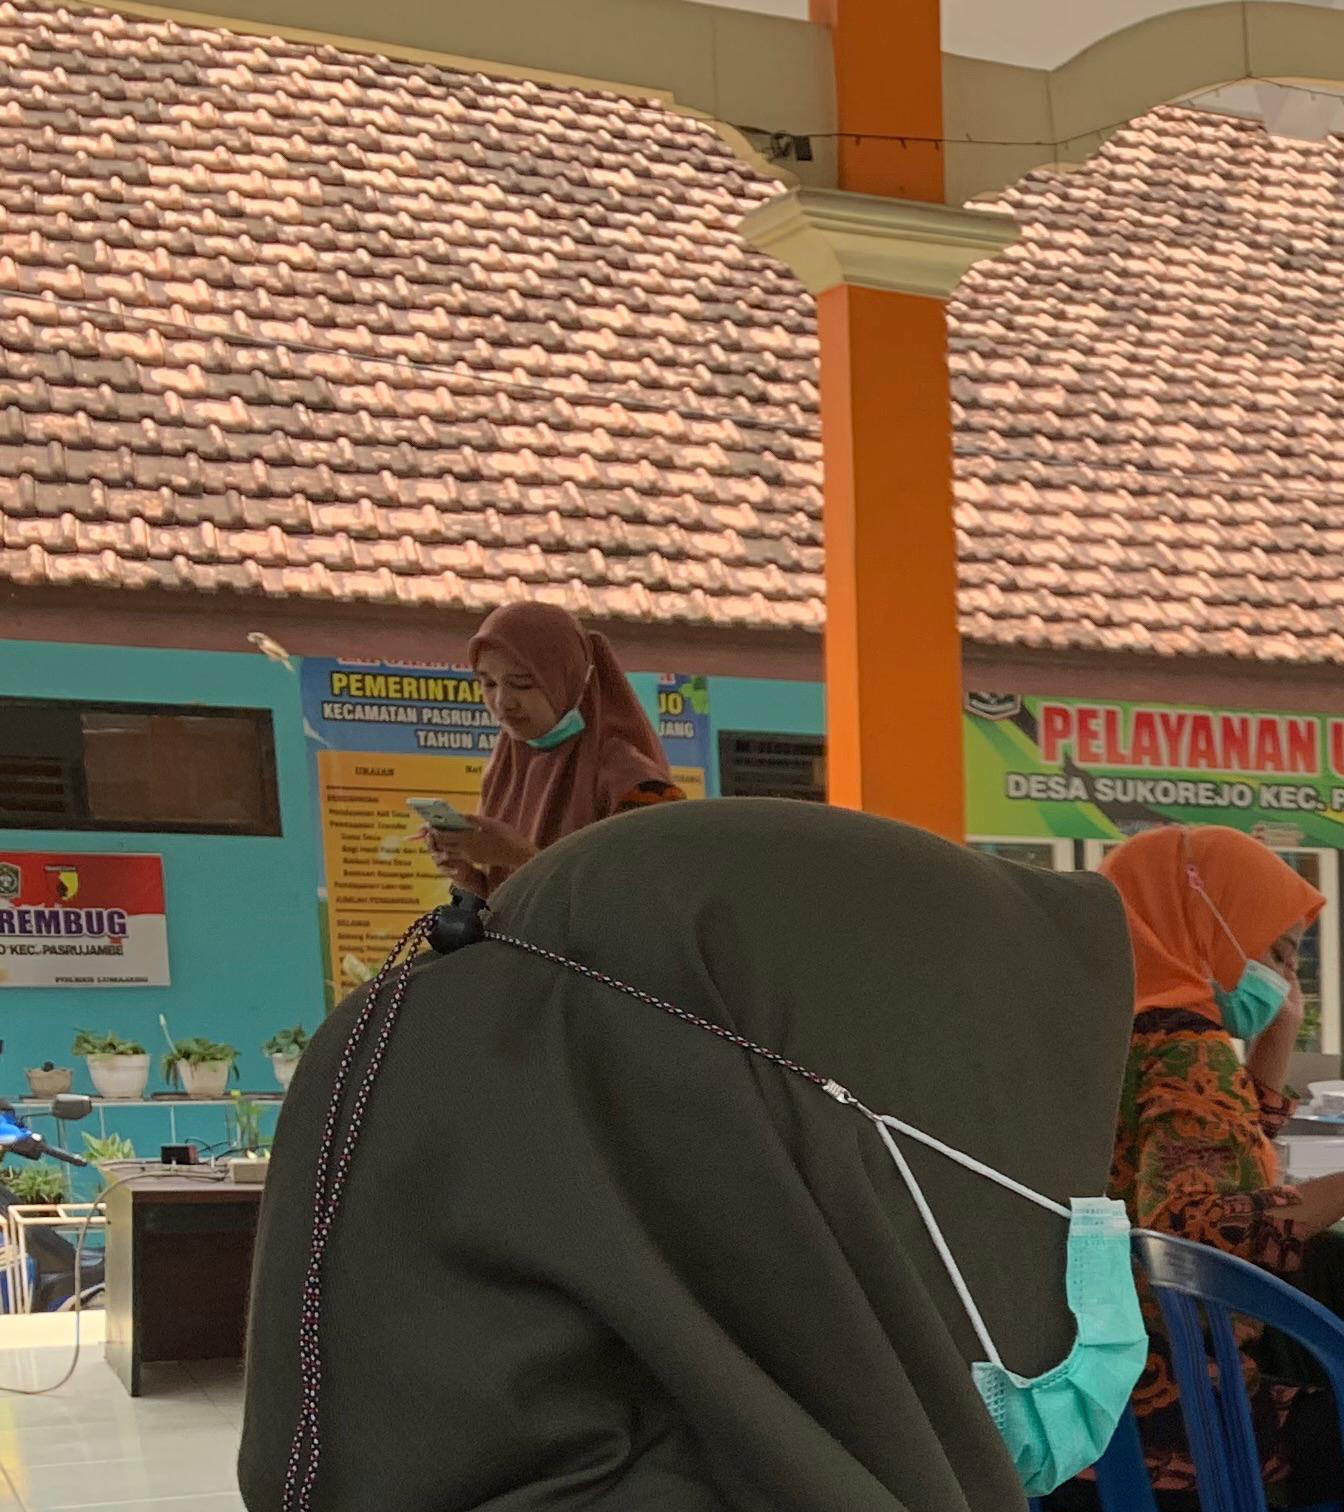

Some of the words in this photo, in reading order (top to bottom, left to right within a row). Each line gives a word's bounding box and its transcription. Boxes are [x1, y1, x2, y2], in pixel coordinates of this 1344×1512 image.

[323, 703, 417, 724] KECAMATAN
[421, 705, 499, 727] PASRUJA
[417, 731, 472, 749] TAHUN
[1040, 705, 1319, 775] PELAYANAN
[1006, 773, 1089, 801] DESA
[1094, 777, 1253, 809] SUKOREJO
[1260, 783, 1324, 812] KEC.
[0, 908, 127, 936] REMBUG
[42, 943, 124, 957] PASRUJAMBE
